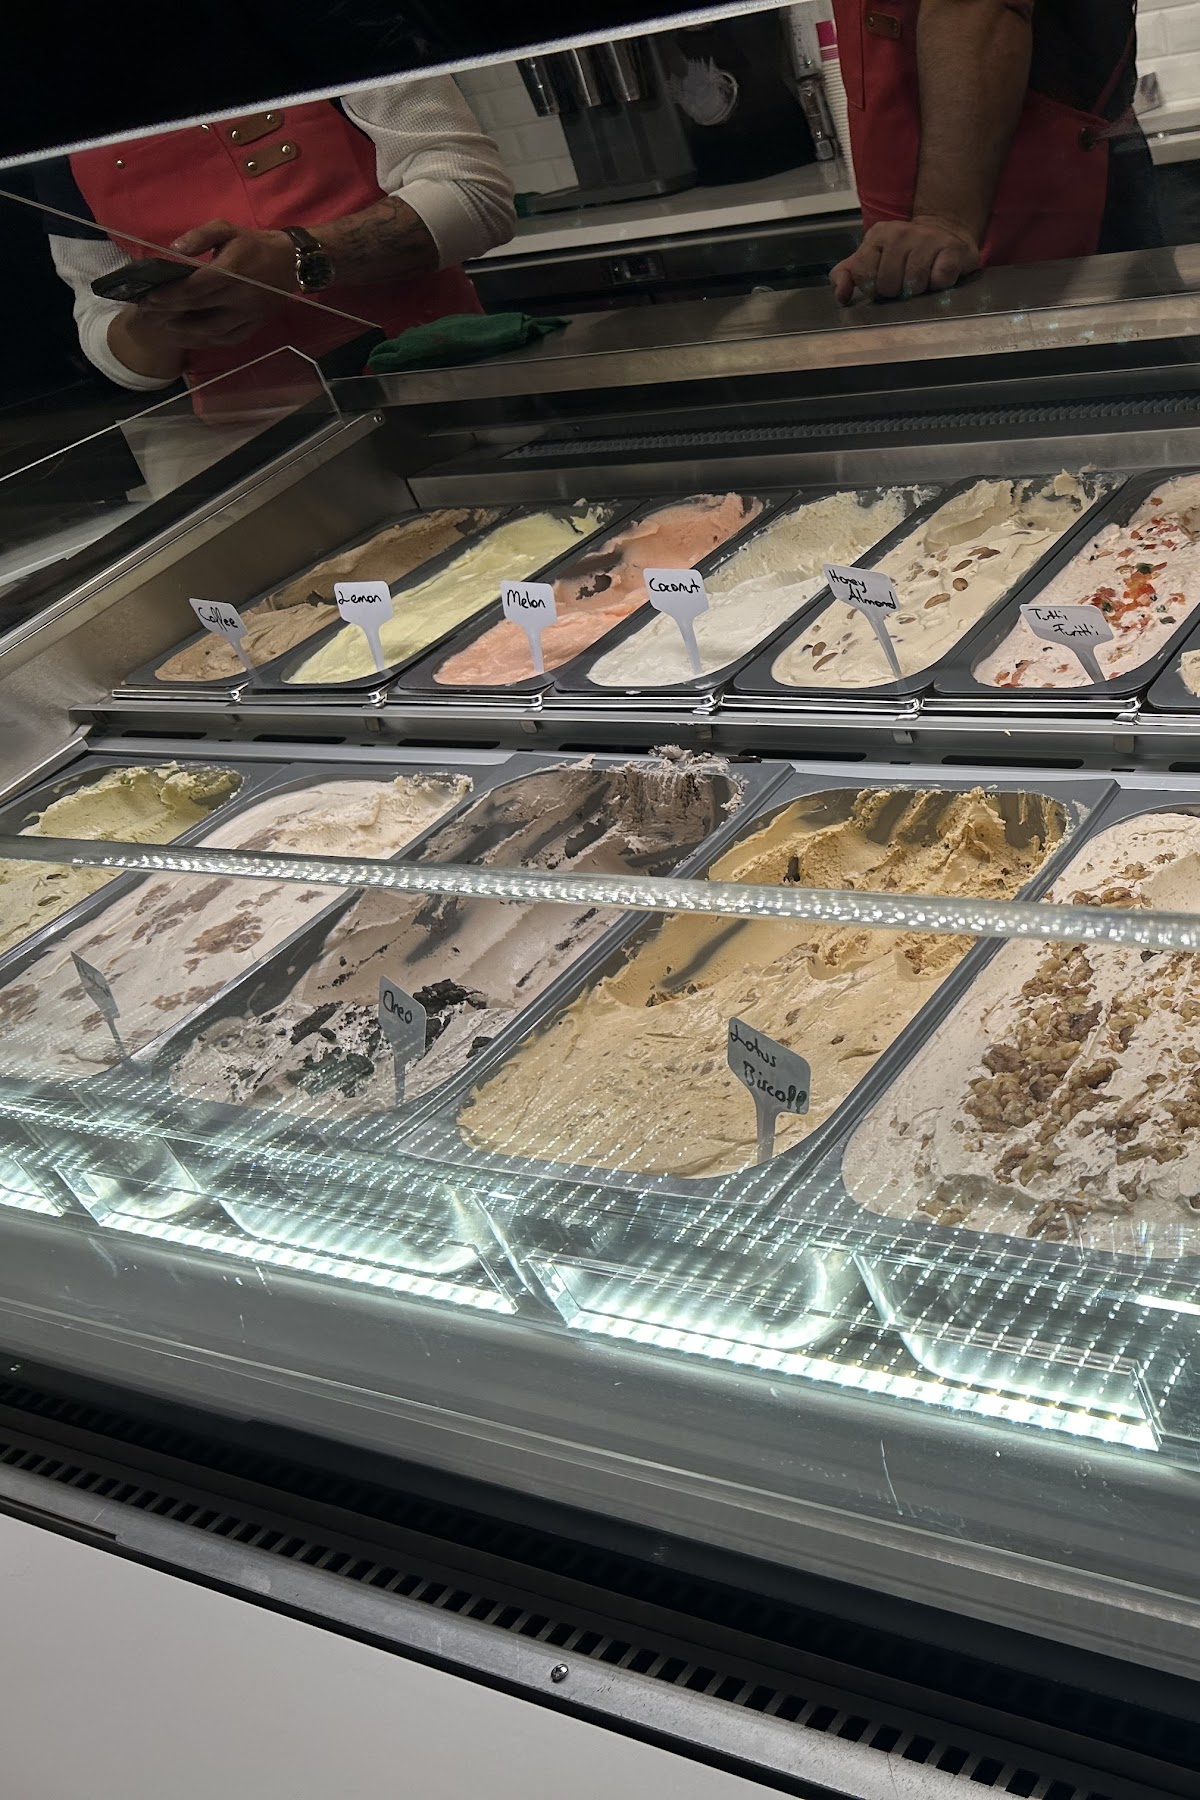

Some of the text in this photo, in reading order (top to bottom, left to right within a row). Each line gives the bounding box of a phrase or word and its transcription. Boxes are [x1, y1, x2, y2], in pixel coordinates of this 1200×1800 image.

[338, 590, 382, 605] Lemon
[649, 577, 701, 594] Coconut
[848, 583, 896, 609] Almond
[507, 589, 546, 609] Melon
[198, 606, 238, 632] Coffee
[383, 990, 412, 1024] Oreo
[730, 1024, 777, 1067] Lotus
